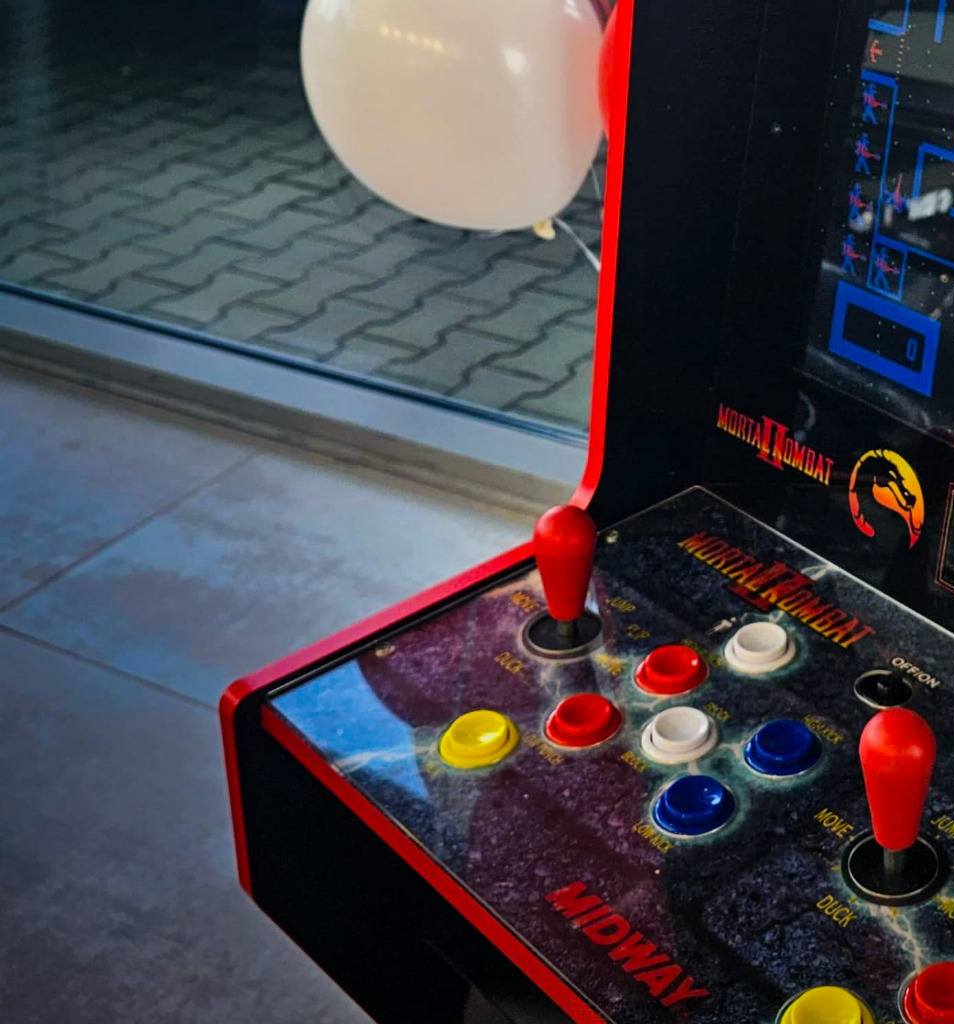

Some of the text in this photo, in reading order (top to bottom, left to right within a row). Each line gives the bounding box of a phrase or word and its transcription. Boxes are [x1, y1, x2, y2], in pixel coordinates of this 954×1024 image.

[717, 403, 835, 486] MORTAL KOMBAT
[676, 530, 876, 649] MORTAL KOMBAT
[891, 657, 940, 689] OFF/ON
[813, 808, 855, 839] MOVE
[816, 894, 858, 927] DUCK
[544, 881, 711, 1007] MIDWAY
